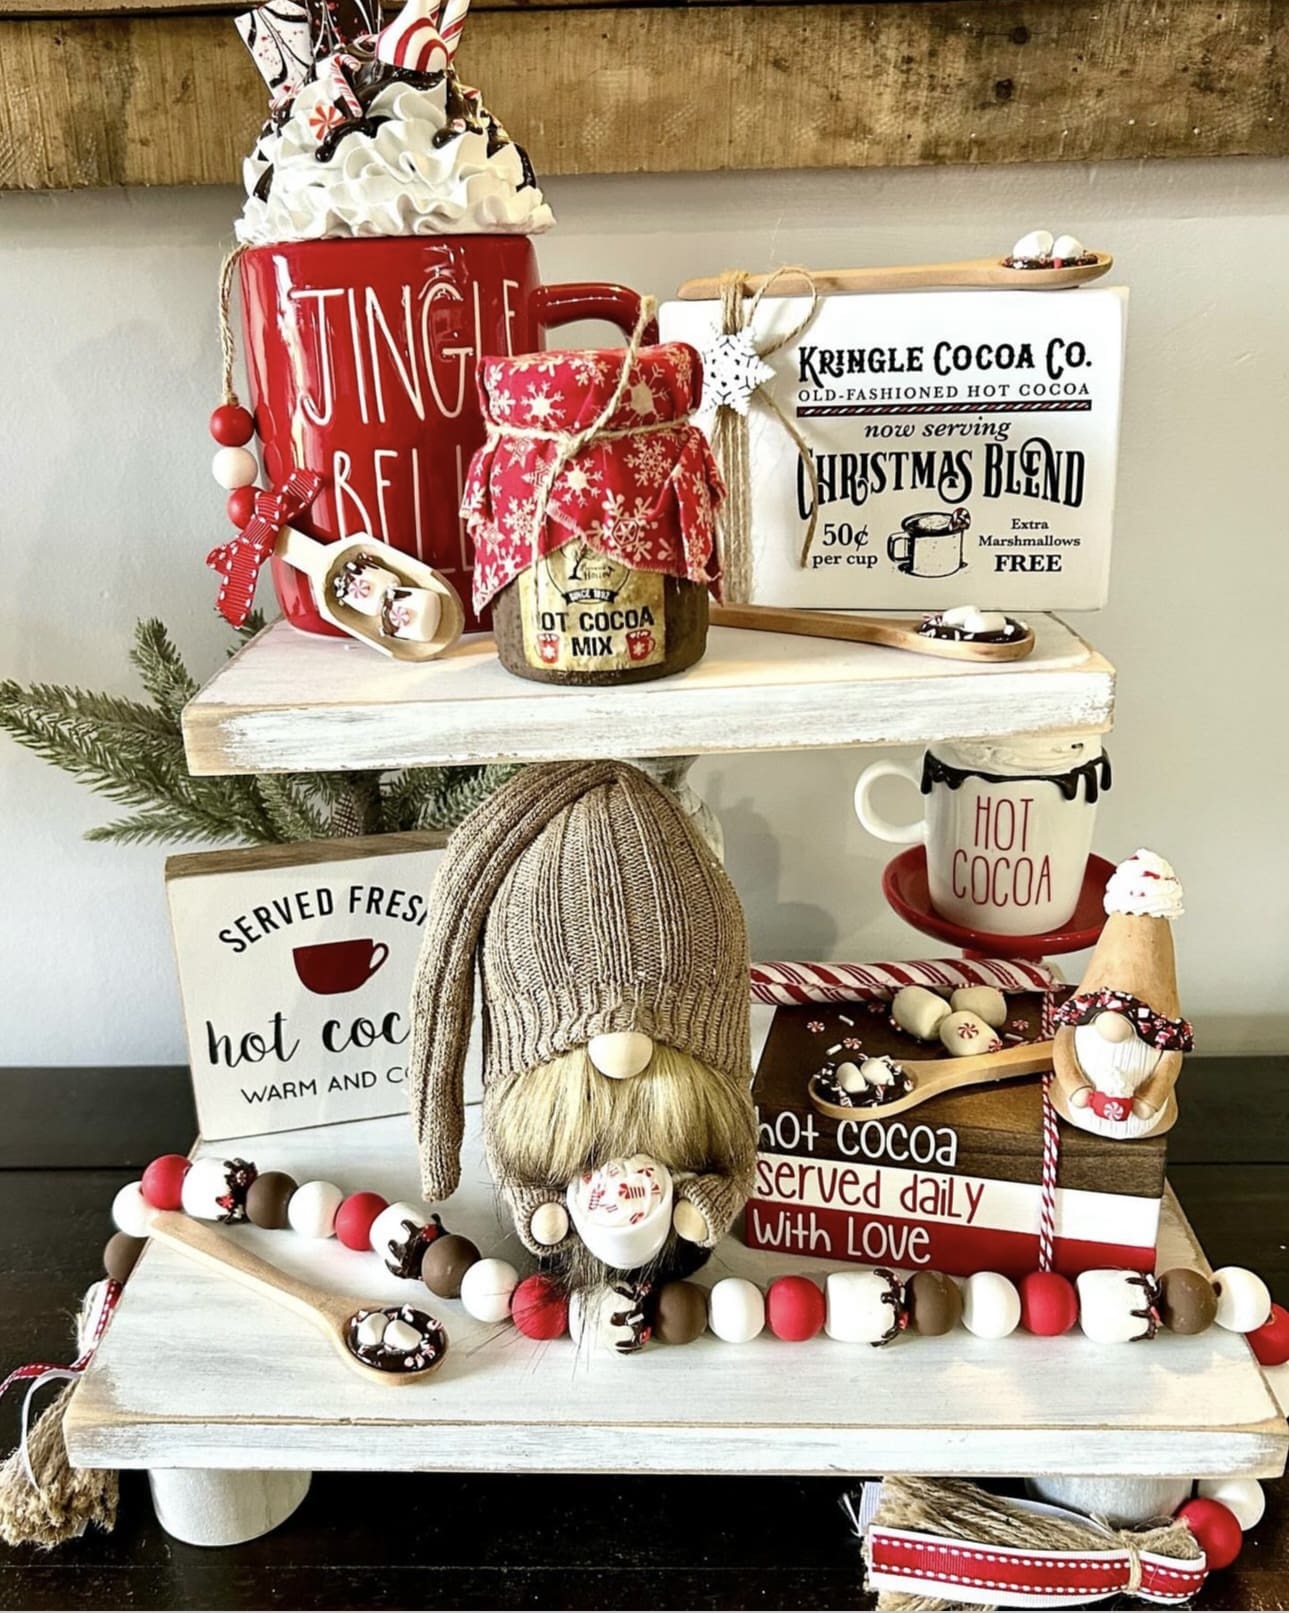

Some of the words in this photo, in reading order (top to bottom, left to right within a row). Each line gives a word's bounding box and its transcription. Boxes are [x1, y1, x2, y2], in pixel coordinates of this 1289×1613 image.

[798, 346, 924, 388] KRINGLE
[933, 340, 1043, 376] COCOA
[1046, 338, 1092, 380] CO.
[798, 386, 958, 402] OLD-FASHIONED
[967, 384, 1010, 398] HOT
[1018, 382, 1090, 396] COCOA
[864, 422, 915, 438] now
[922, 416, 1011, 441] serving
[797, 448, 973, 520] CHRISTMAS
[982, 436, 1085, 508] BLEND
[822, 523, 868, 552] 50¢
[978, 534, 1081, 547] Marshmallows
[1011, 518, 1049, 530] Extra
[812, 554, 841, 570] per
[846, 553, 878, 570] cup
[994, 554, 1062, 572] FREE
[539, 611, 570, 633] OT
[579, 605, 655, 632] COCOA
[571, 635, 614, 657] MIX
[974, 795, 1034, 852] HOT
[952, 848, 1052, 907] COCOA
[218, 888, 334, 953] SERVED
[206, 1011, 300, 1068] hot
[241, 1079, 318, 1104] WARM
[327, 1070, 377, 1093] AND
[836, 1119, 958, 1167] cocoa
[757, 1159, 881, 1209] served
[753, 1208, 831, 1252] With
